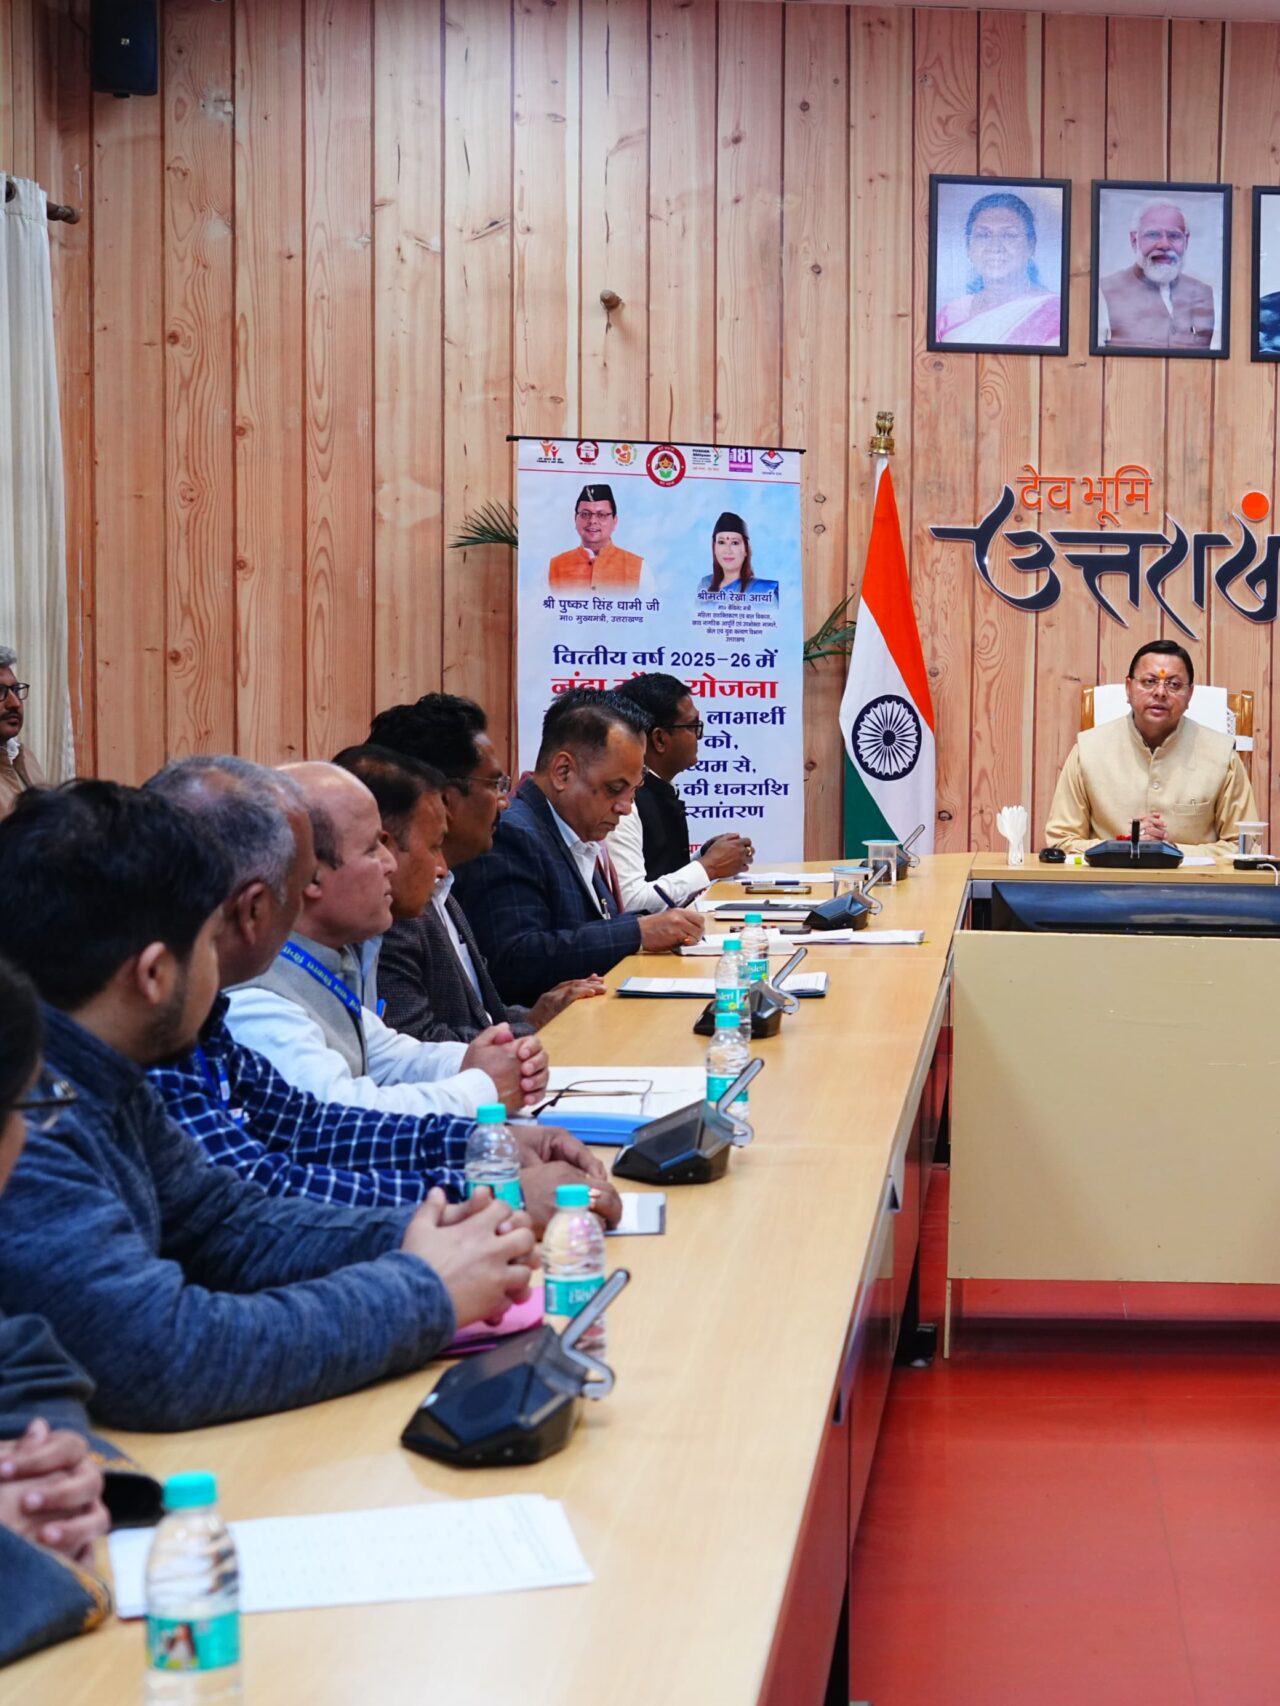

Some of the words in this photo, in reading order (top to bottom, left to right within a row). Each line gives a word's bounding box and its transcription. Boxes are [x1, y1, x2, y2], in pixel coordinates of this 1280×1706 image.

[730, 448, 752, 463] 181
[1016, 464, 1076, 513] देव
[1083, 464, 1153, 526] भूमि
[542, 596, 555, 609] श्री
[558, 599, 589, 613] पुष्कर
[592, 596, 613, 611] सिंह
[617, 598, 642, 611] धामी
[646, 598, 660, 612] जी
[697, 590, 726, 601] श्रीमती
[729, 591, 746, 602] रेखा
[749, 591, 772, 602] आर्या
[553, 645, 626, 665] वित्तीय
[632, 646, 666, 666] वर्ष
[671, 652, 750, 667] 2025-26
[755, 648, 779, 668] में
[685, 672, 778, 698] योजना
[706, 706, 787, 725] लाभार्थी
[704, 730, 738, 750] को,
[732, 755, 757, 773] से,
[683, 778, 709, 796] की
[714, 778, 789, 796] धनराशि
[684, 801, 765, 818] स्तांतरण
